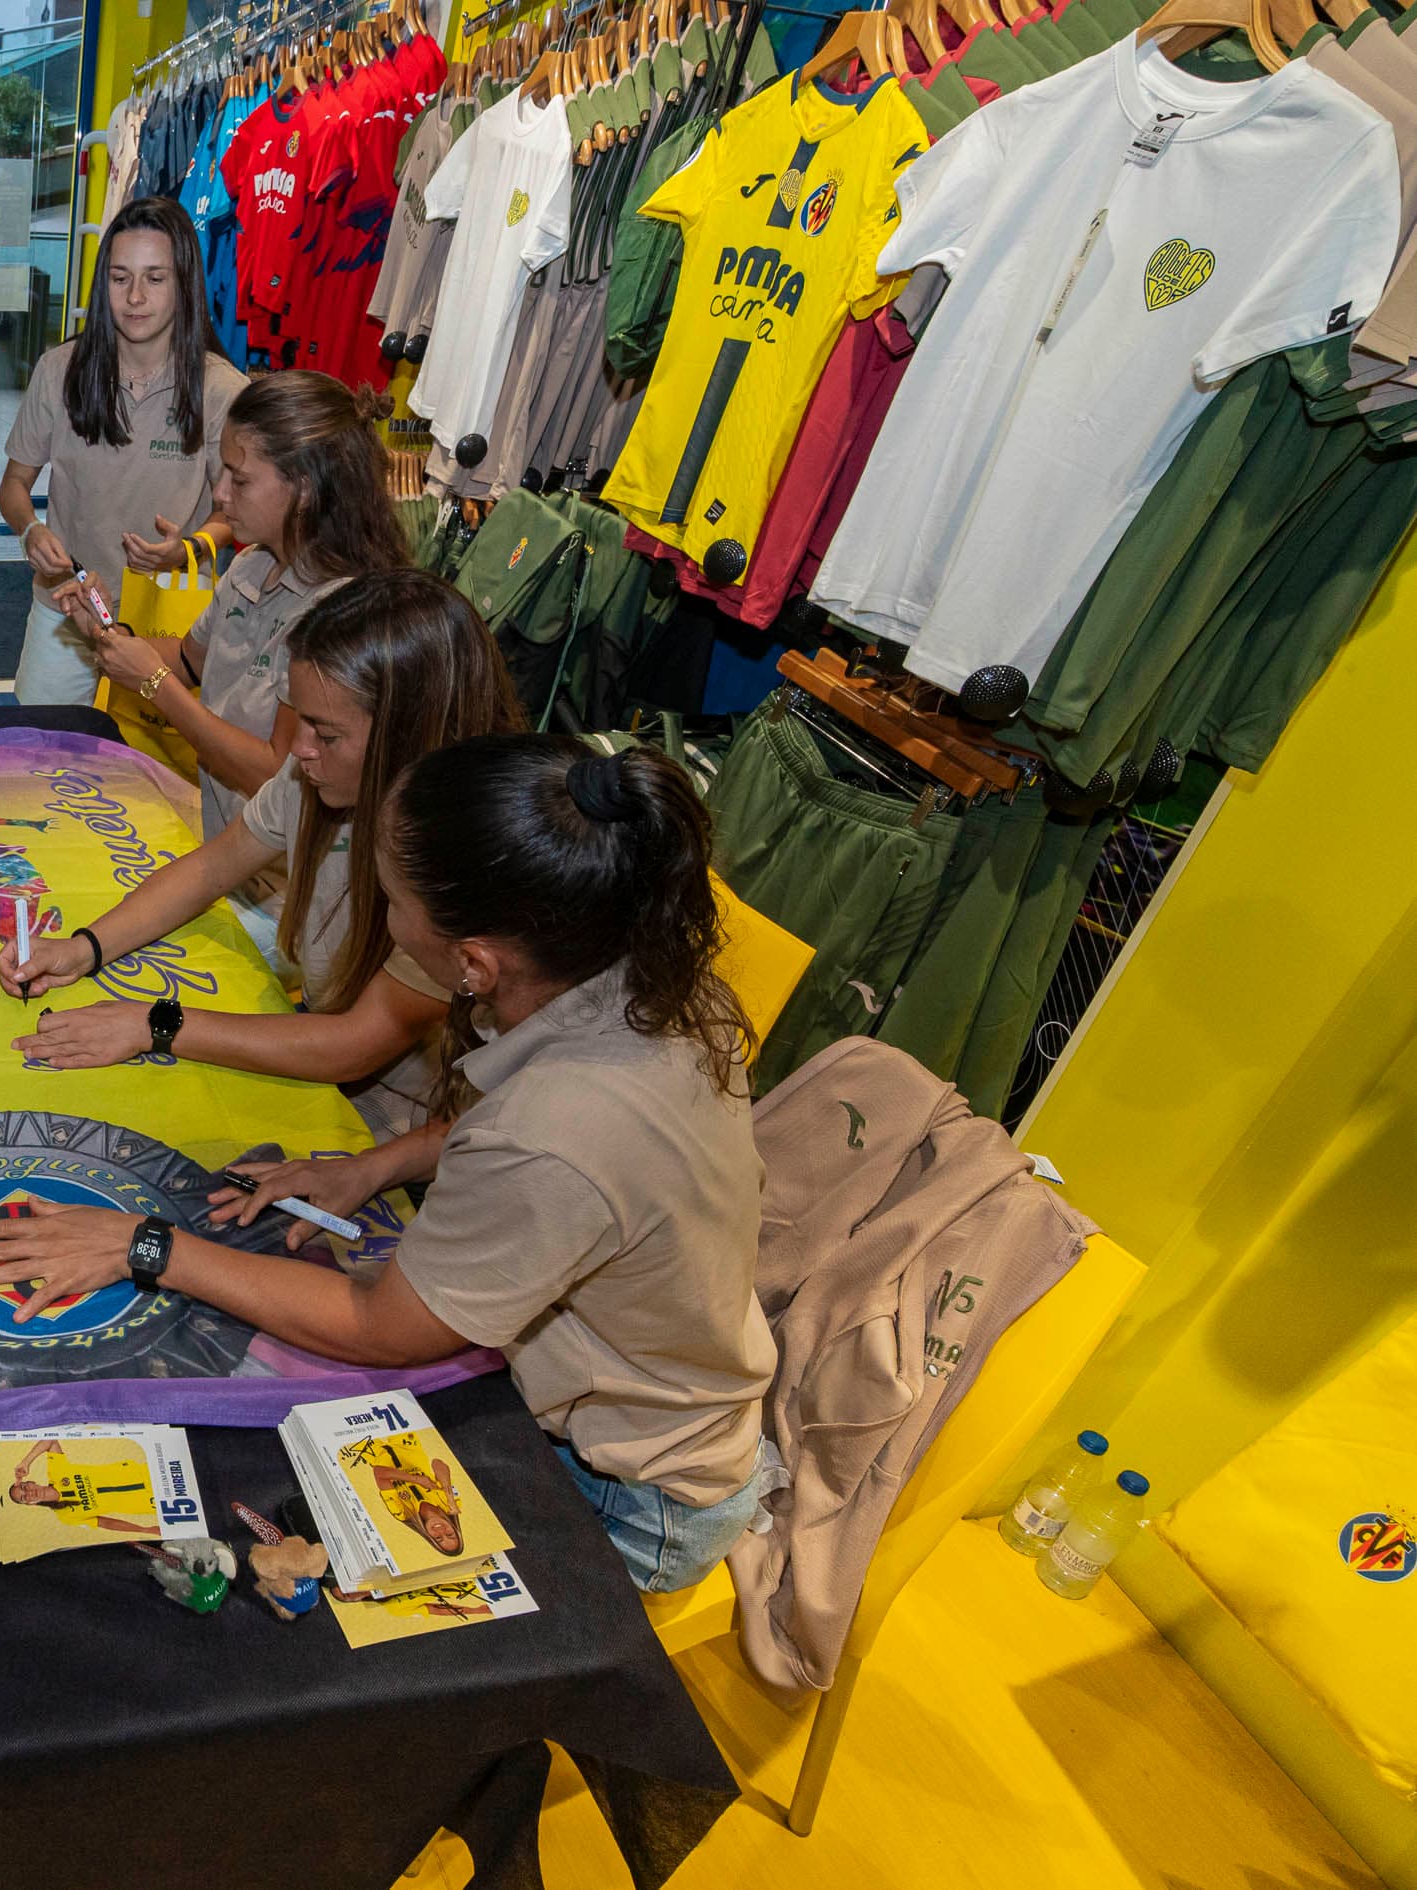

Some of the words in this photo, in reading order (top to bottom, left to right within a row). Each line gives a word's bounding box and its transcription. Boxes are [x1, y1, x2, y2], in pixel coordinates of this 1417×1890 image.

[136, 1241, 162, 1259] 18:38
[344, 1413, 375, 1426] NEREA
[370, 1403, 410, 1431] 14
[170, 1460, 184, 1497] MOREIRA
[159, 1498, 200, 1526] 15
[477, 1570, 522, 1603] 15
